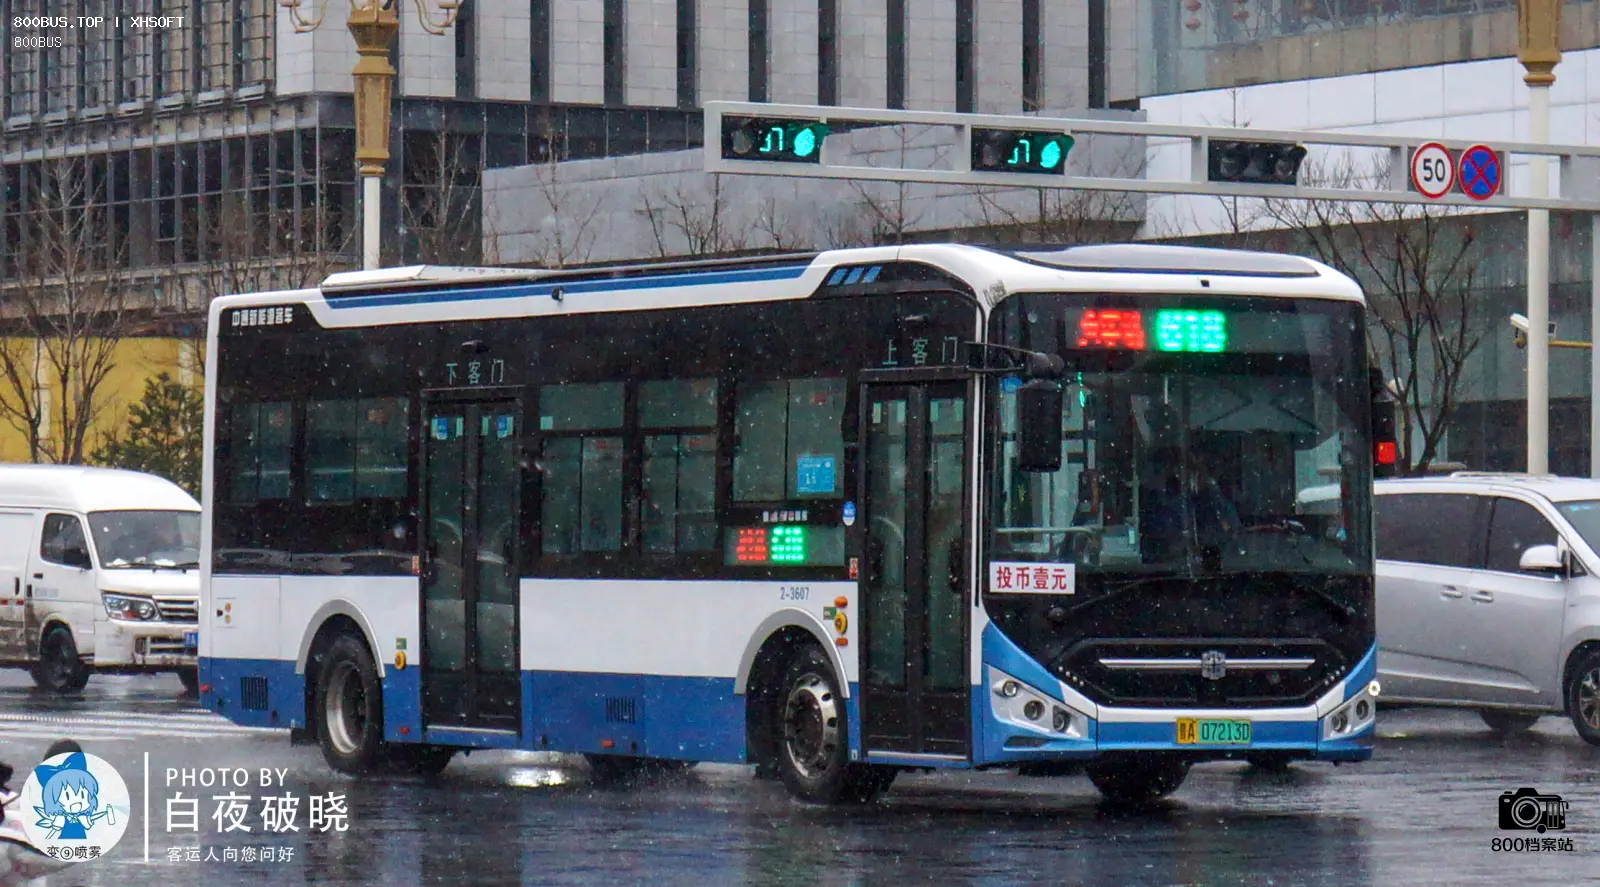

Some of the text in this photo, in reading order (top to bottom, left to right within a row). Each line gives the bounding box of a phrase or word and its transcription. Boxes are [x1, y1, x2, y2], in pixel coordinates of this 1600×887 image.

[1423, 158, 1446, 182] 50
[882, 336, 958, 365] 上客门
[446, 359, 504, 385] 下客门
[996, 565, 1068, 591] 投币壹元
[780, 586, 810, 601] 2-3607
